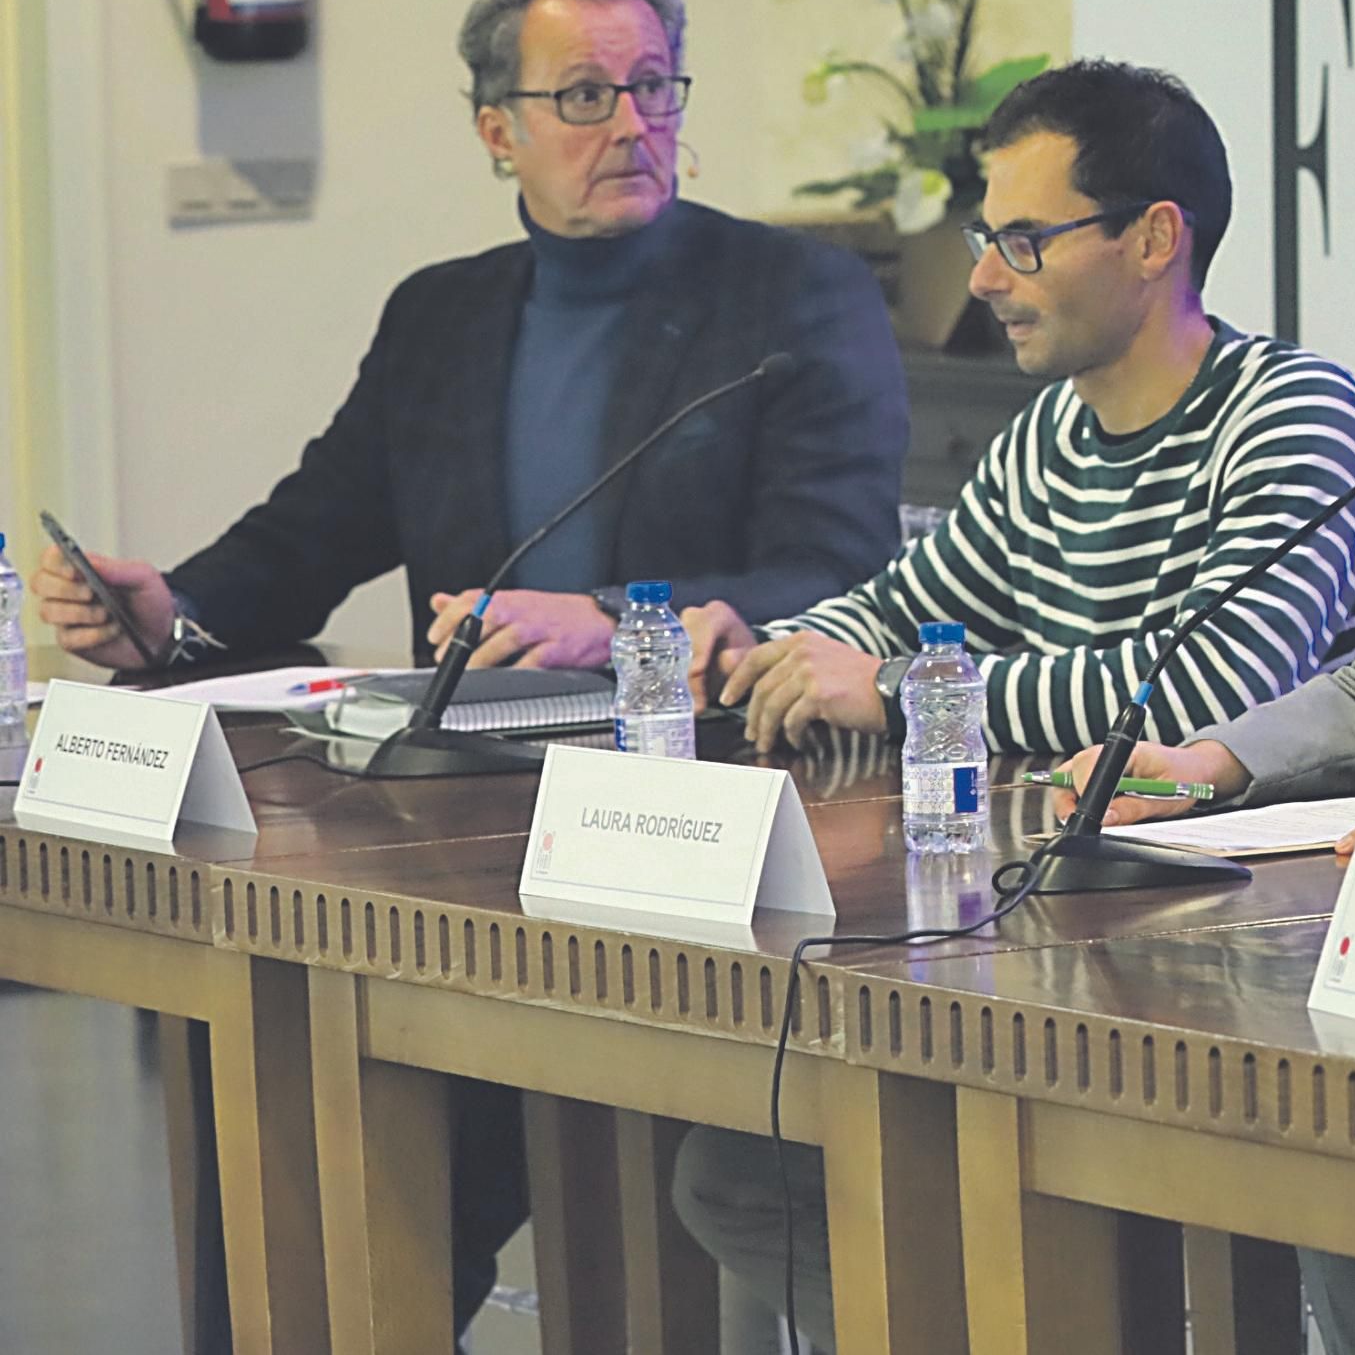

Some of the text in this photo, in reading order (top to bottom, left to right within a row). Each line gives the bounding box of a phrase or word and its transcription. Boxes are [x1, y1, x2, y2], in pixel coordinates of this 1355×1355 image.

[55, 733, 170, 769] ALBERTO FERNÁNDEZ
[581, 807, 723, 843] LAURA RODRÍGUEZ
